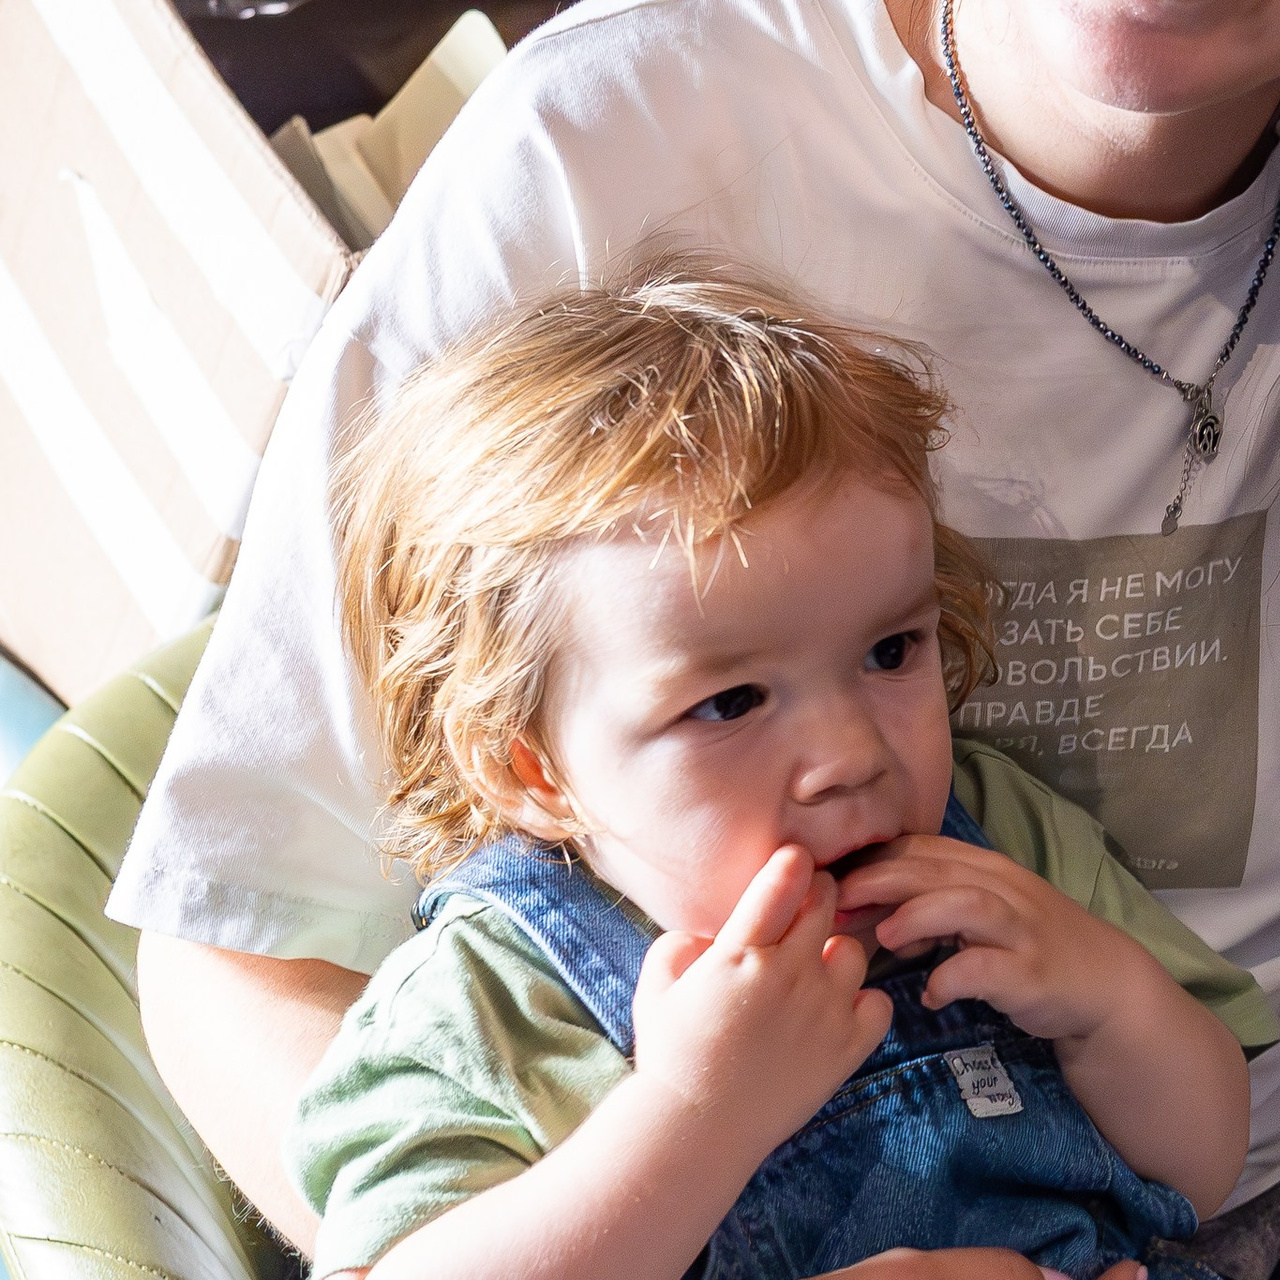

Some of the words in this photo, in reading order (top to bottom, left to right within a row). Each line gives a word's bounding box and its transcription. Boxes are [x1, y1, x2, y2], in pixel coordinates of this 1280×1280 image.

[1066, 578, 1090, 606] Я
[1099, 572, 1146, 603] НЕ
[1155, 556, 1245, 597] МОГУ
[1095, 606, 1184, 642] СЕБЕ
[997, 638, 1228, 688] ВОЛЬСТВИИ.
[958, 694, 1105, 727] ПРАВДЕ
[1057, 722, 1194, 755] ВСЕГДА
